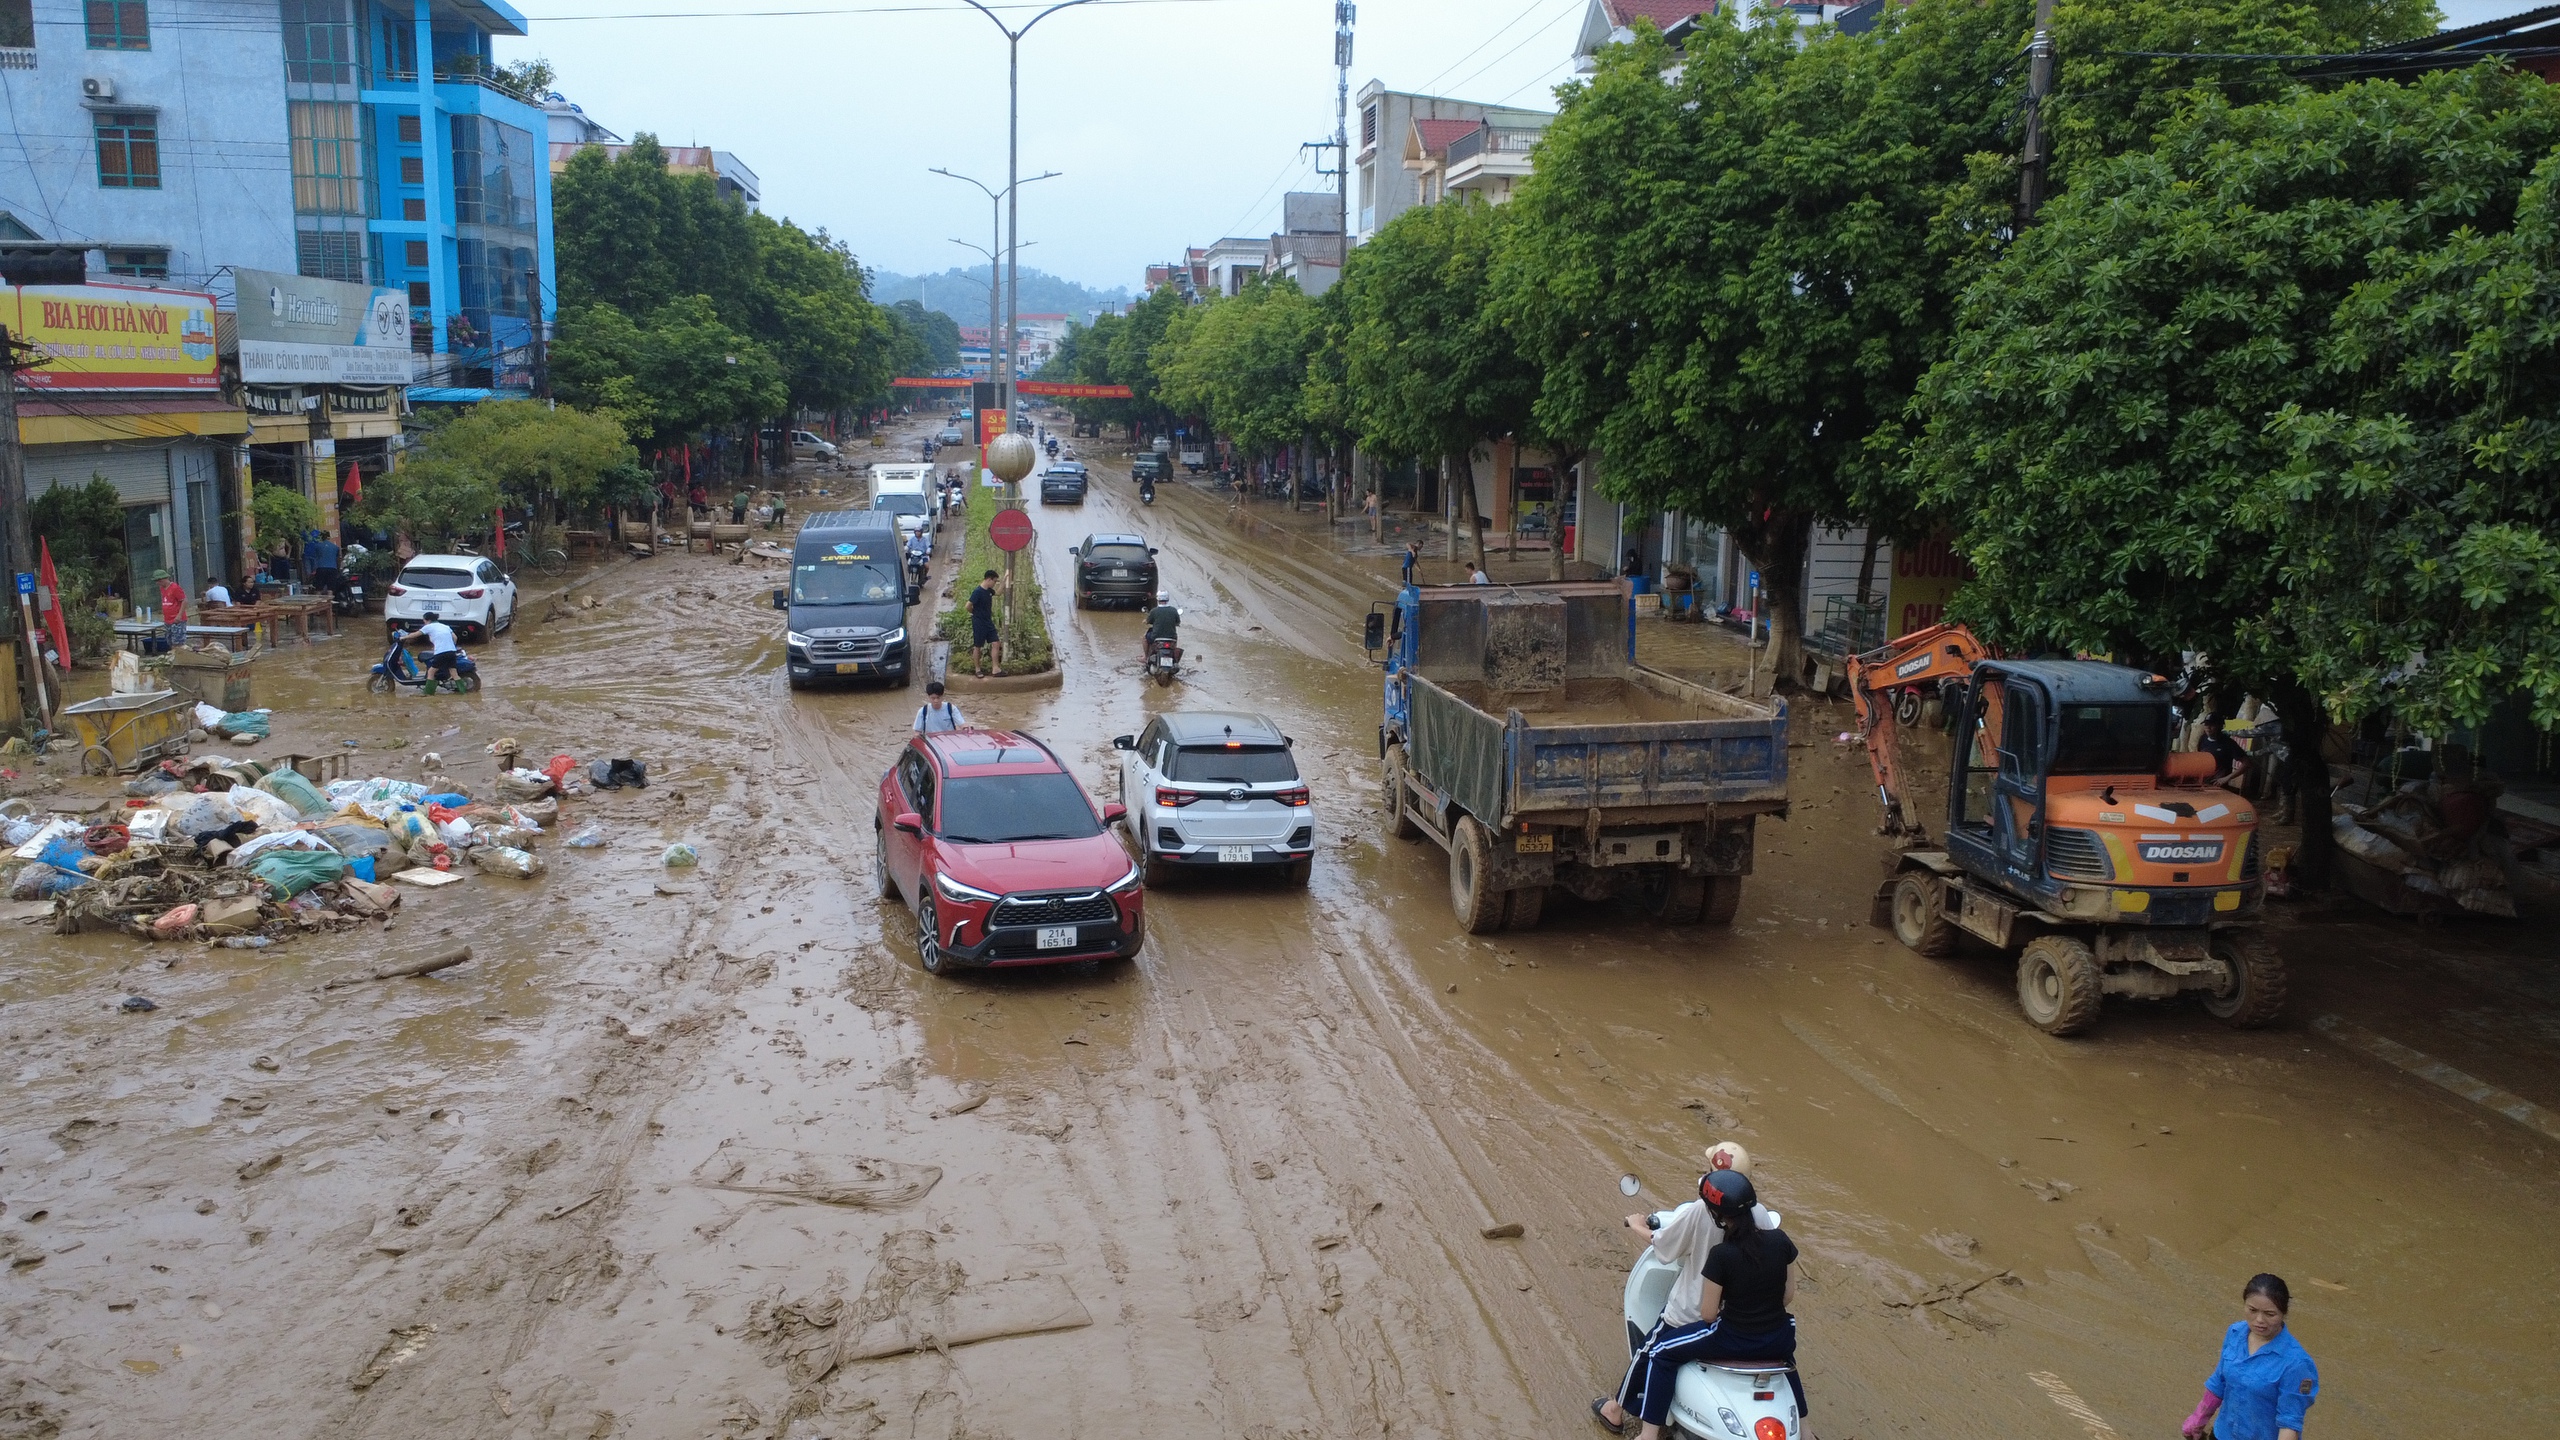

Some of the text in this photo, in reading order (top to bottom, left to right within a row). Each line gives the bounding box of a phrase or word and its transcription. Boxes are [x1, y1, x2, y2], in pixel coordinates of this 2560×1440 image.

[286, 293, 338, 326] Havoline
[42, 300, 169, 340] BIA HƠI HÀ NỘI
[242, 349, 330, 371] THÀNH CÔNG MOTOR
[1898, 655, 1930, 677] DOOSAN
[1223, 853, 1249, 861] 179.16
[2146, 846, 2218, 858] DOOSAN
[1042, 937, 1073, 947] 165.18
[1048, 929, 1066, 938] 21A
